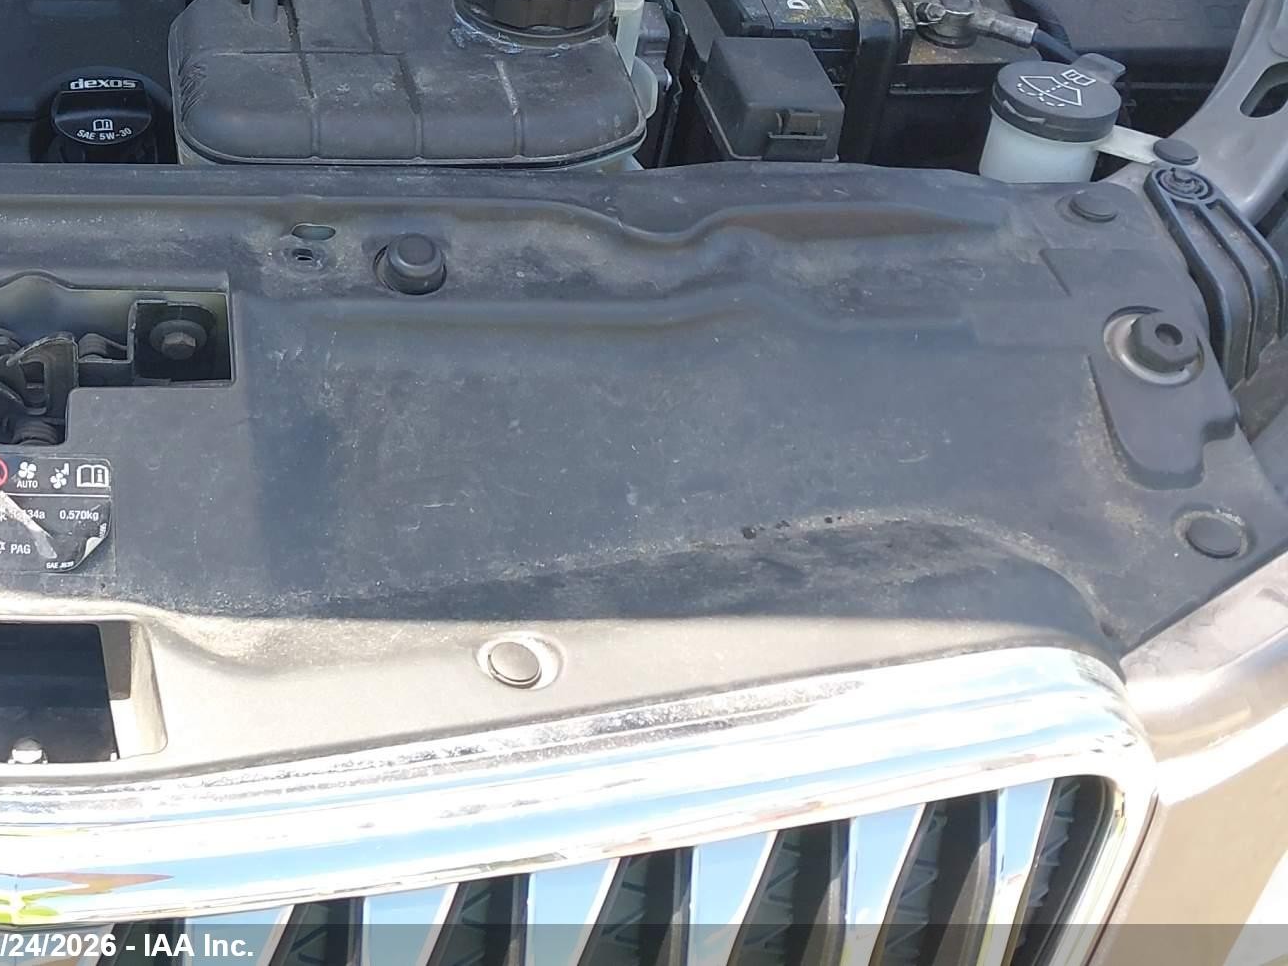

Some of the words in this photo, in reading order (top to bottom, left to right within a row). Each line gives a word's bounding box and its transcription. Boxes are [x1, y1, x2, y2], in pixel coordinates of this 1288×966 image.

[70, 78, 136, 90] dexos
[76, 129, 96, 140] SAE
[99, 127, 132, 141] 5W-30
[16, 480, 38, 489] AUTO
[10, 544, 31, 554] PAG
